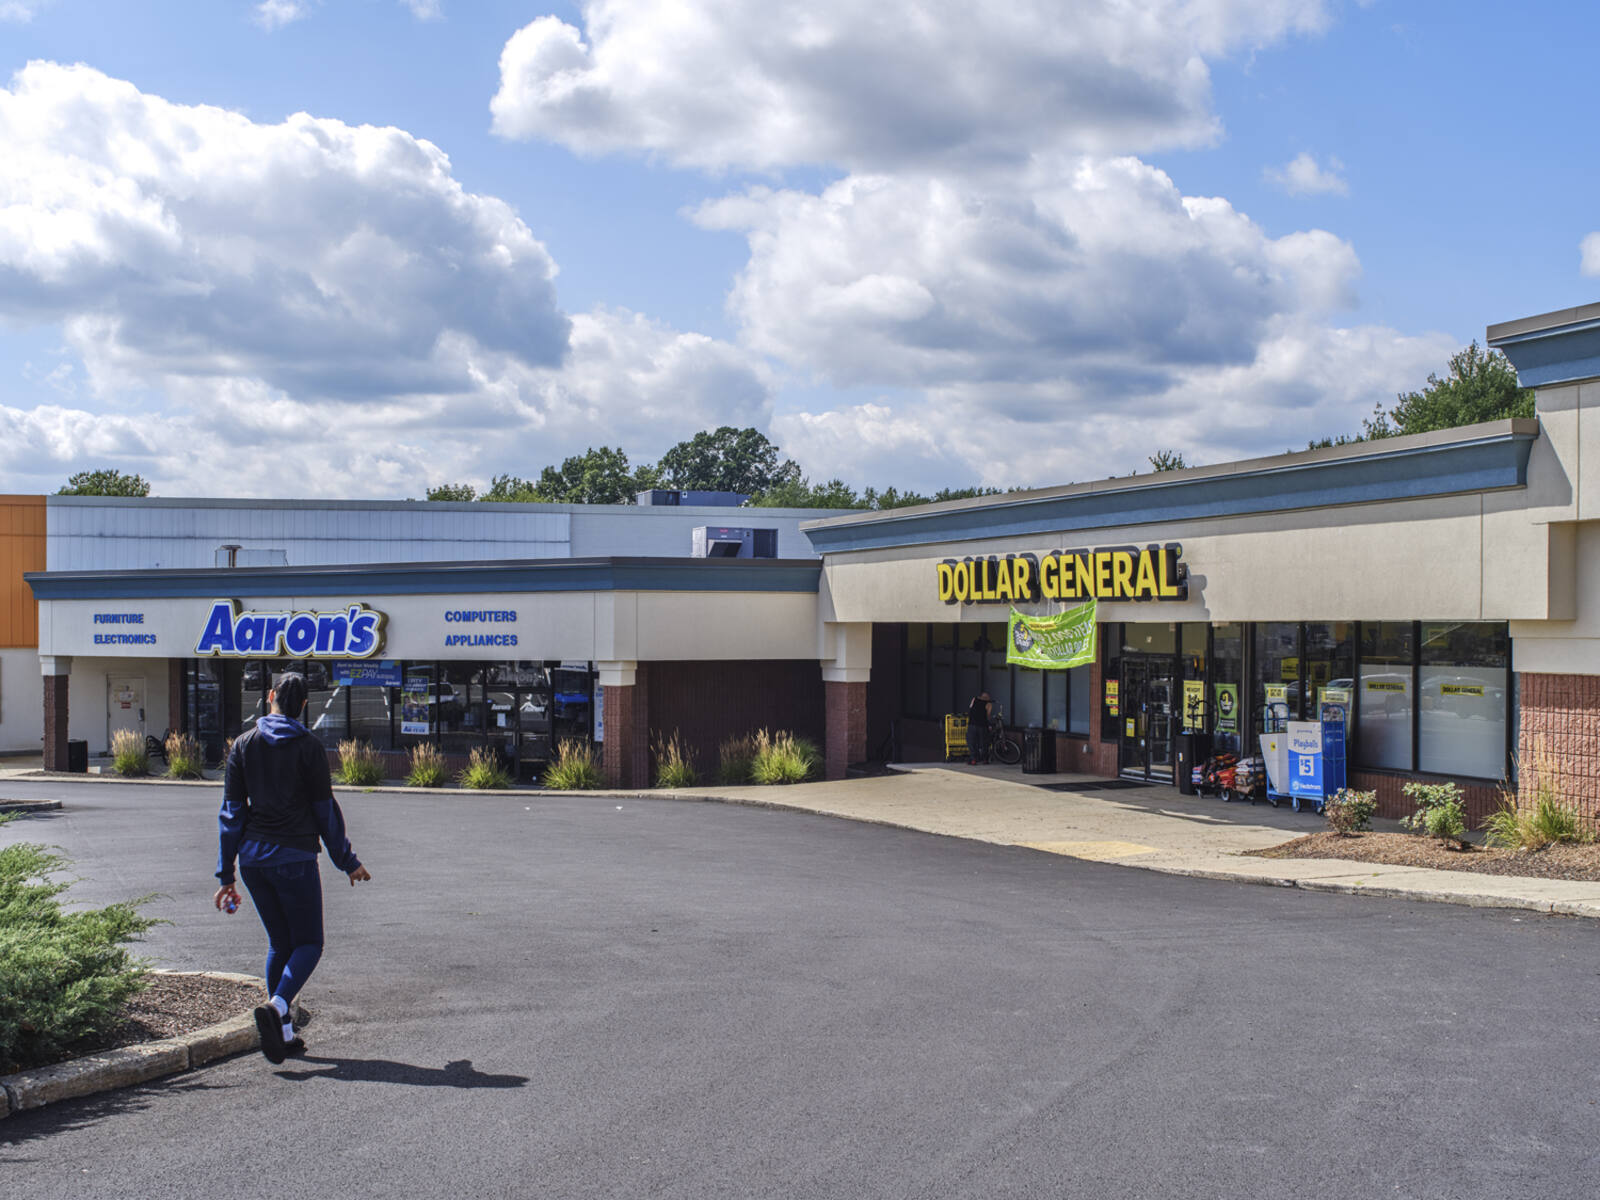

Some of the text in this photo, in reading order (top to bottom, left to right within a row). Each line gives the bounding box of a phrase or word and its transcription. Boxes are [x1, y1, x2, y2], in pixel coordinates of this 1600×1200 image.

[937, 549, 1178, 601] DOLLAR GENERAL
[93, 613, 145, 624] FURNITURE
[444, 610, 518, 623] COMPUTERS
[195, 599, 382, 656] Aaron's
[93, 634, 157, 645] ELECTRONICS
[444, 634, 519, 647] APPLIANCES
